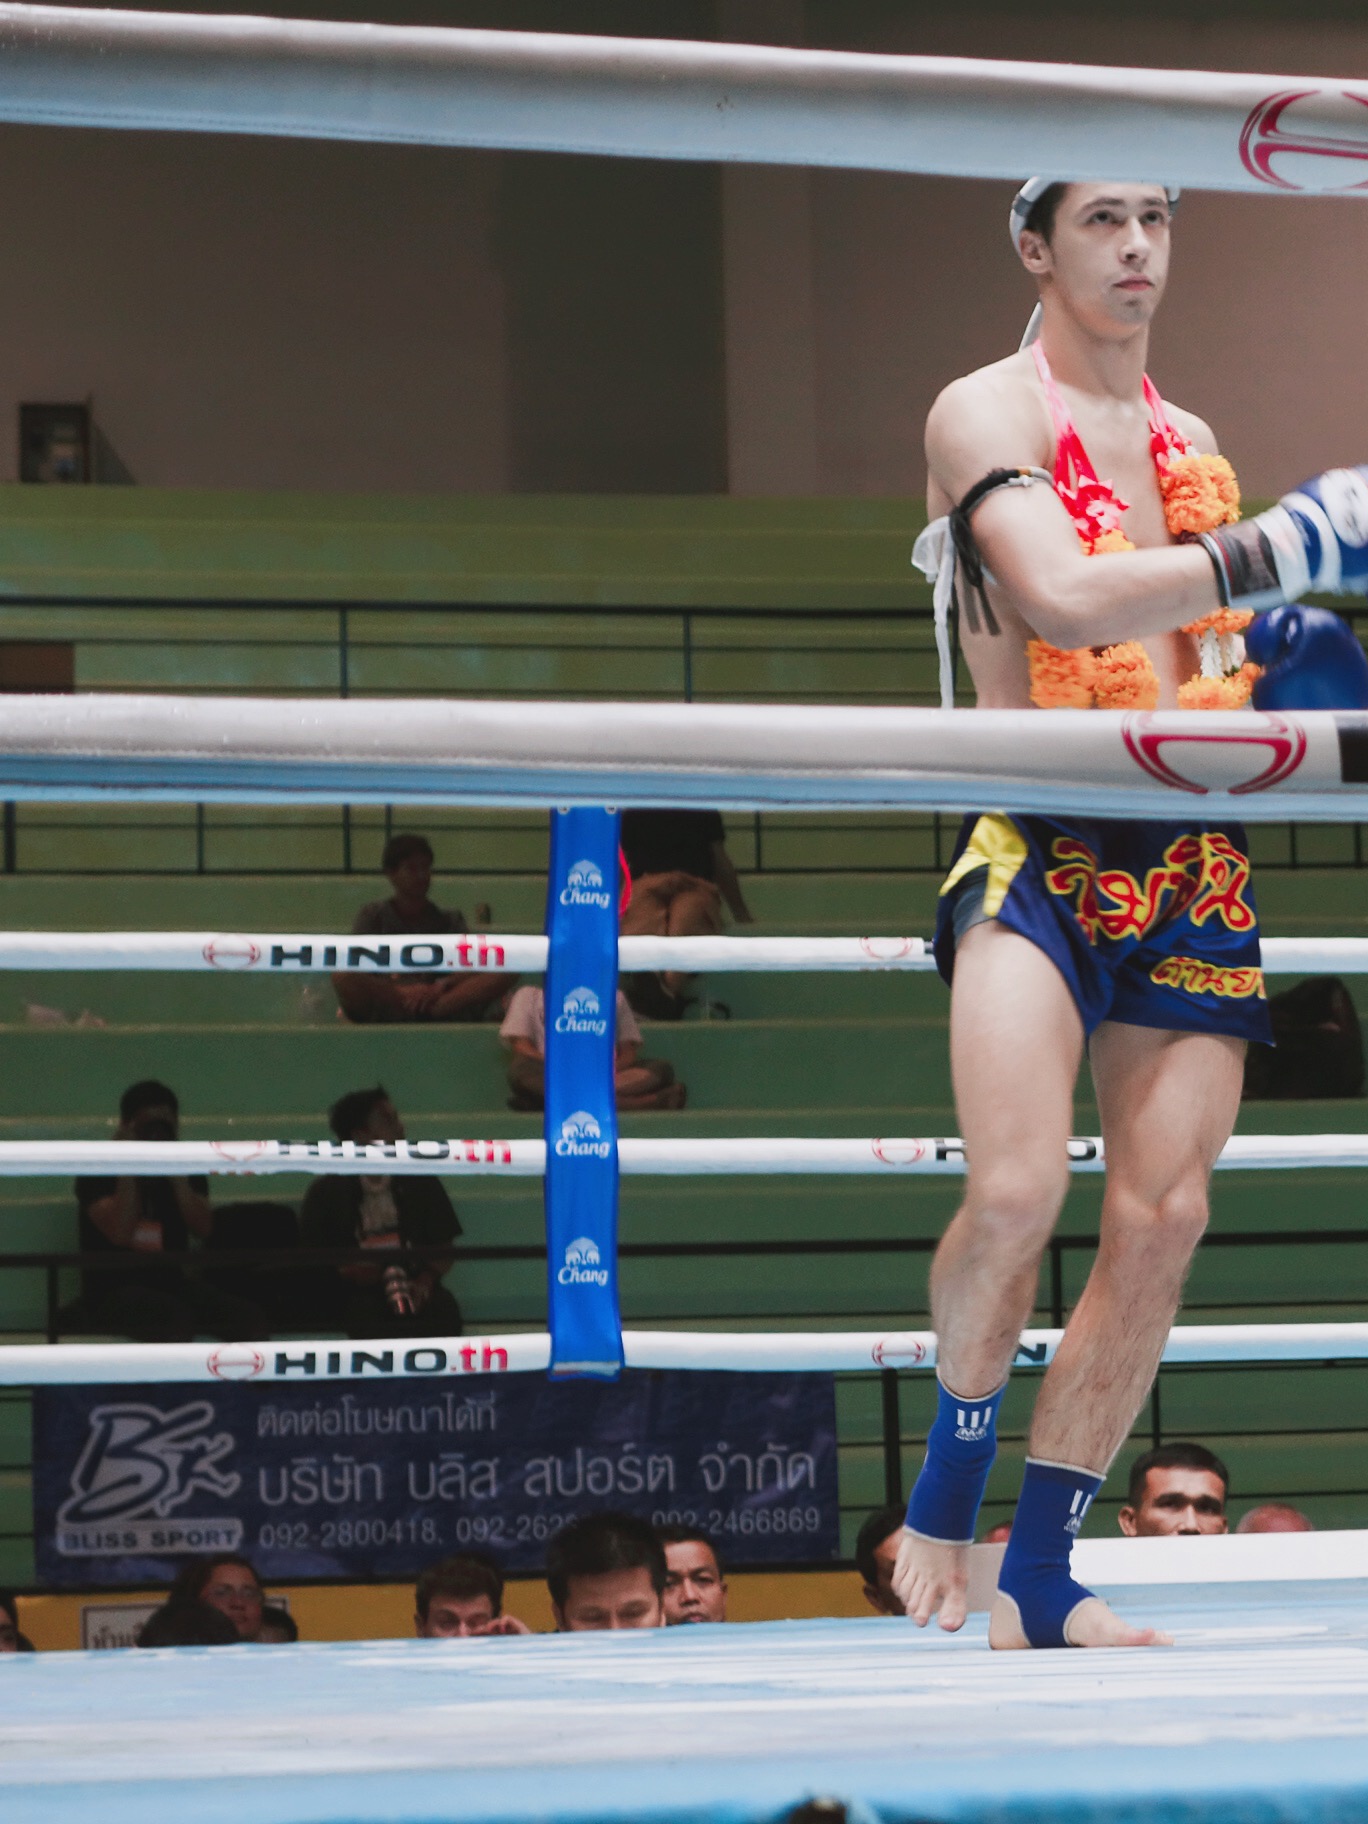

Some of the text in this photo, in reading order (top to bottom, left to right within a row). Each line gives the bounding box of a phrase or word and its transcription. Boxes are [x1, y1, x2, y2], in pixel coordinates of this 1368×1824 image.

[560, 886, 611, 909] Chang
[269, 934, 505, 968] HINO.th
[555, 1014, 606, 1036] Chang
[556, 1137, 610, 1159] Chang
[558, 1266, 608, 1287] Chang
[274, 1337, 508, 1375] HINO.th
[259, 1442, 815, 1506] บริษัท บลิส สปอร์ต จำกัด
[63, 1530, 235, 1549] BLISS SPORT
